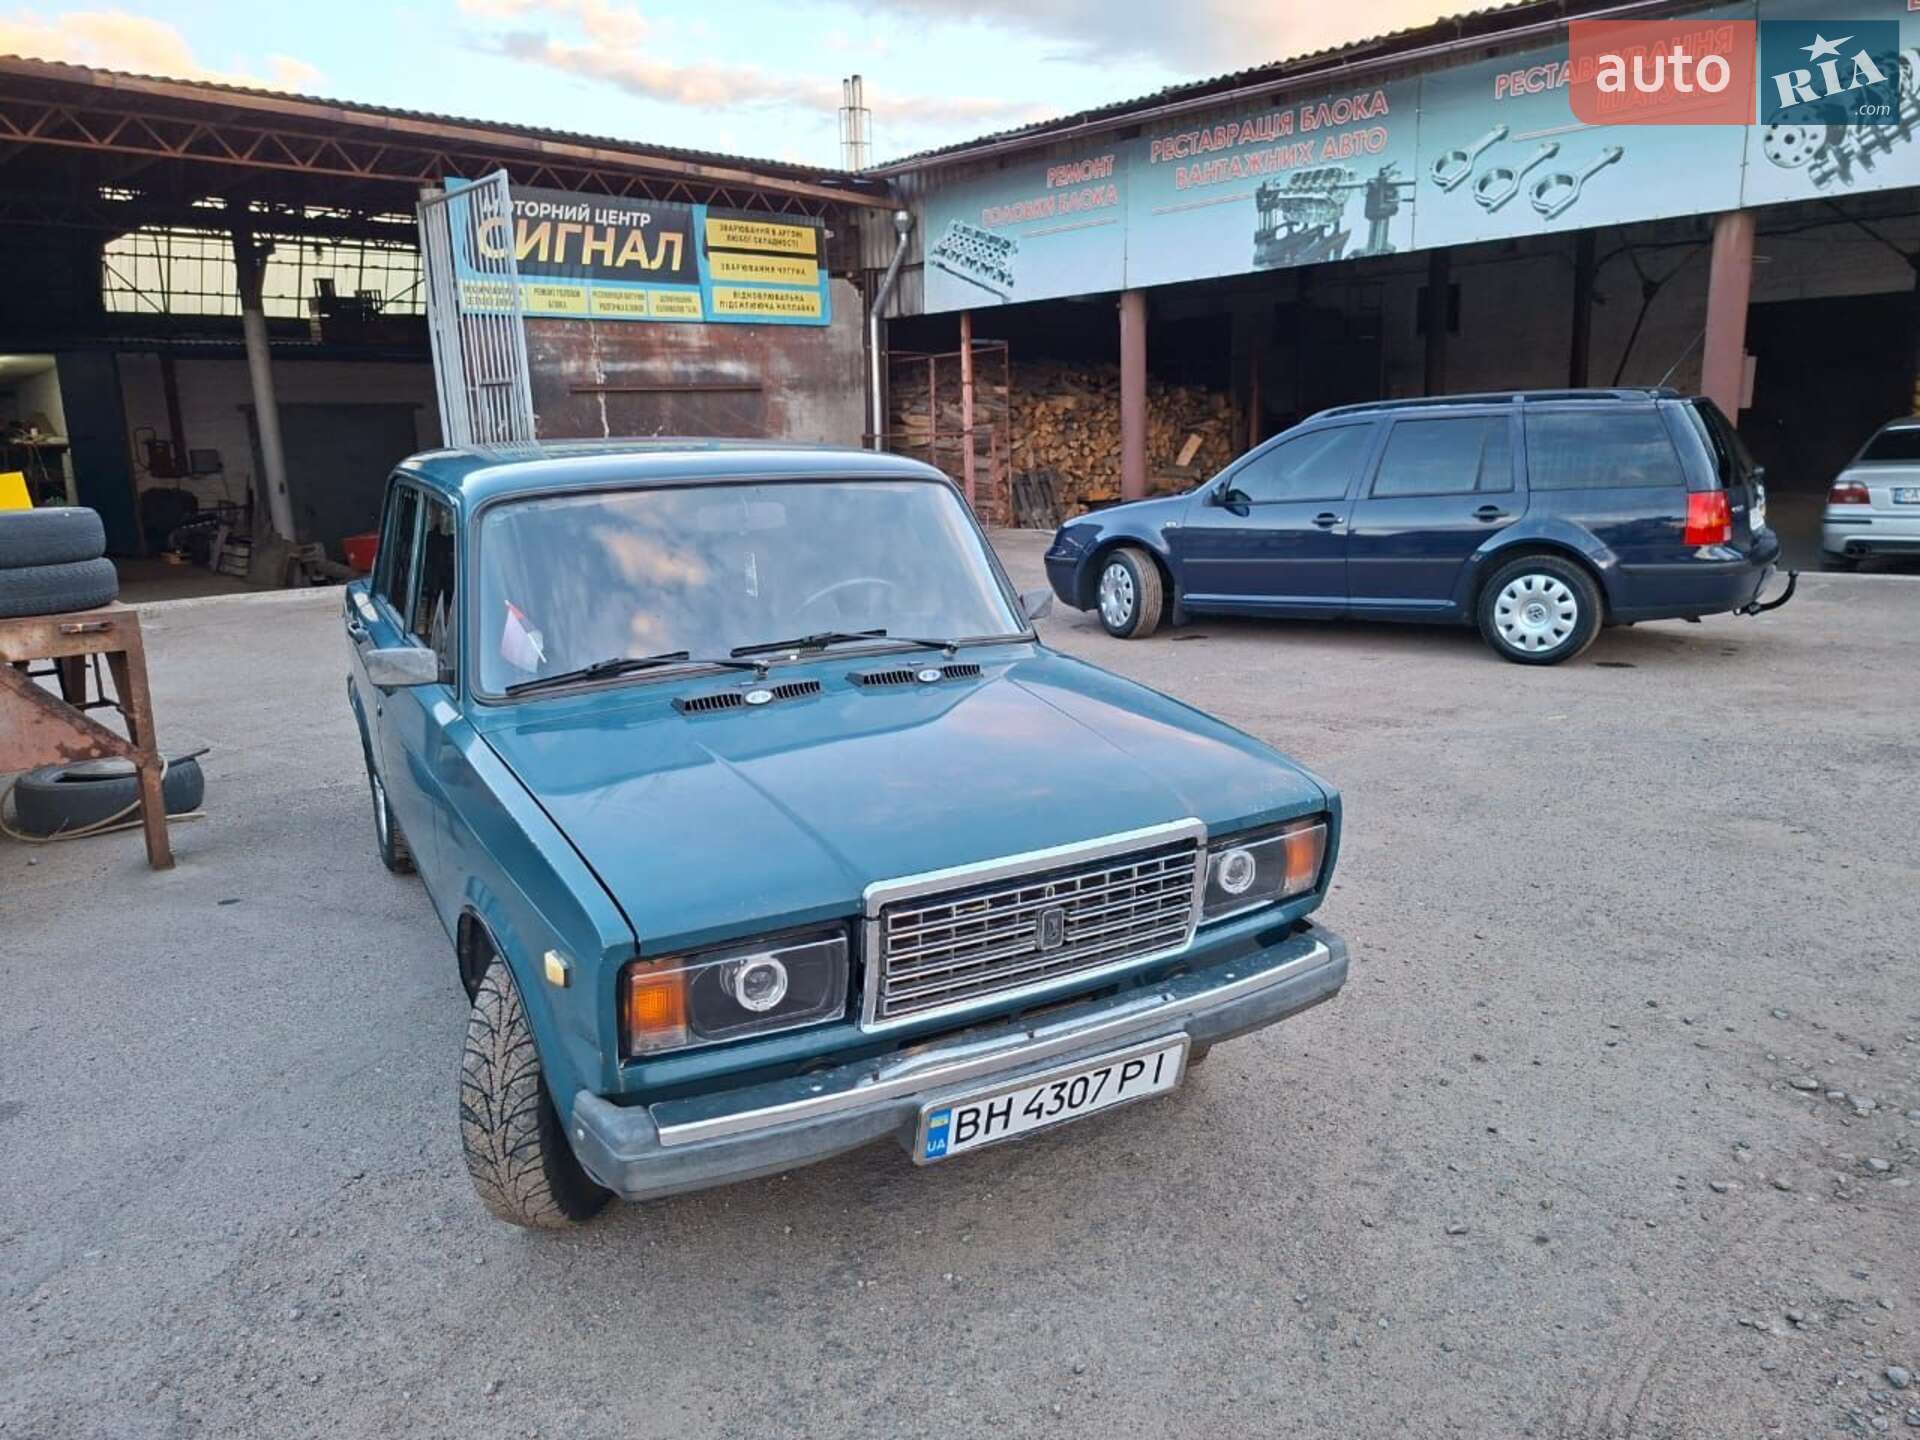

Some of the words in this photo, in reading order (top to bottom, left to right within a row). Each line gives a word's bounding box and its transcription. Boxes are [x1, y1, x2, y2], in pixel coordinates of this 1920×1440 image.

[1150, 110, 1293, 164] РЕСТАВРАЦІЯ
[1300, 90, 1389, 132] БЛОКА
[1046, 154, 1115, 188] РЕМОНТ
[1175, 140, 1315, 190] ВАНТАЖНИХ
[1321, 126, 1389, 159] АВТО
[478, 216, 684, 271] СИГНАЛ
[595, 209, 651, 228] ЦЕНТР
[954, 1097, 1014, 1145] BH
[1023, 1068, 1112, 1120] 4307
[1117, 1053, 1165, 1094] PI
[927, 1139, 946, 1152] UA
